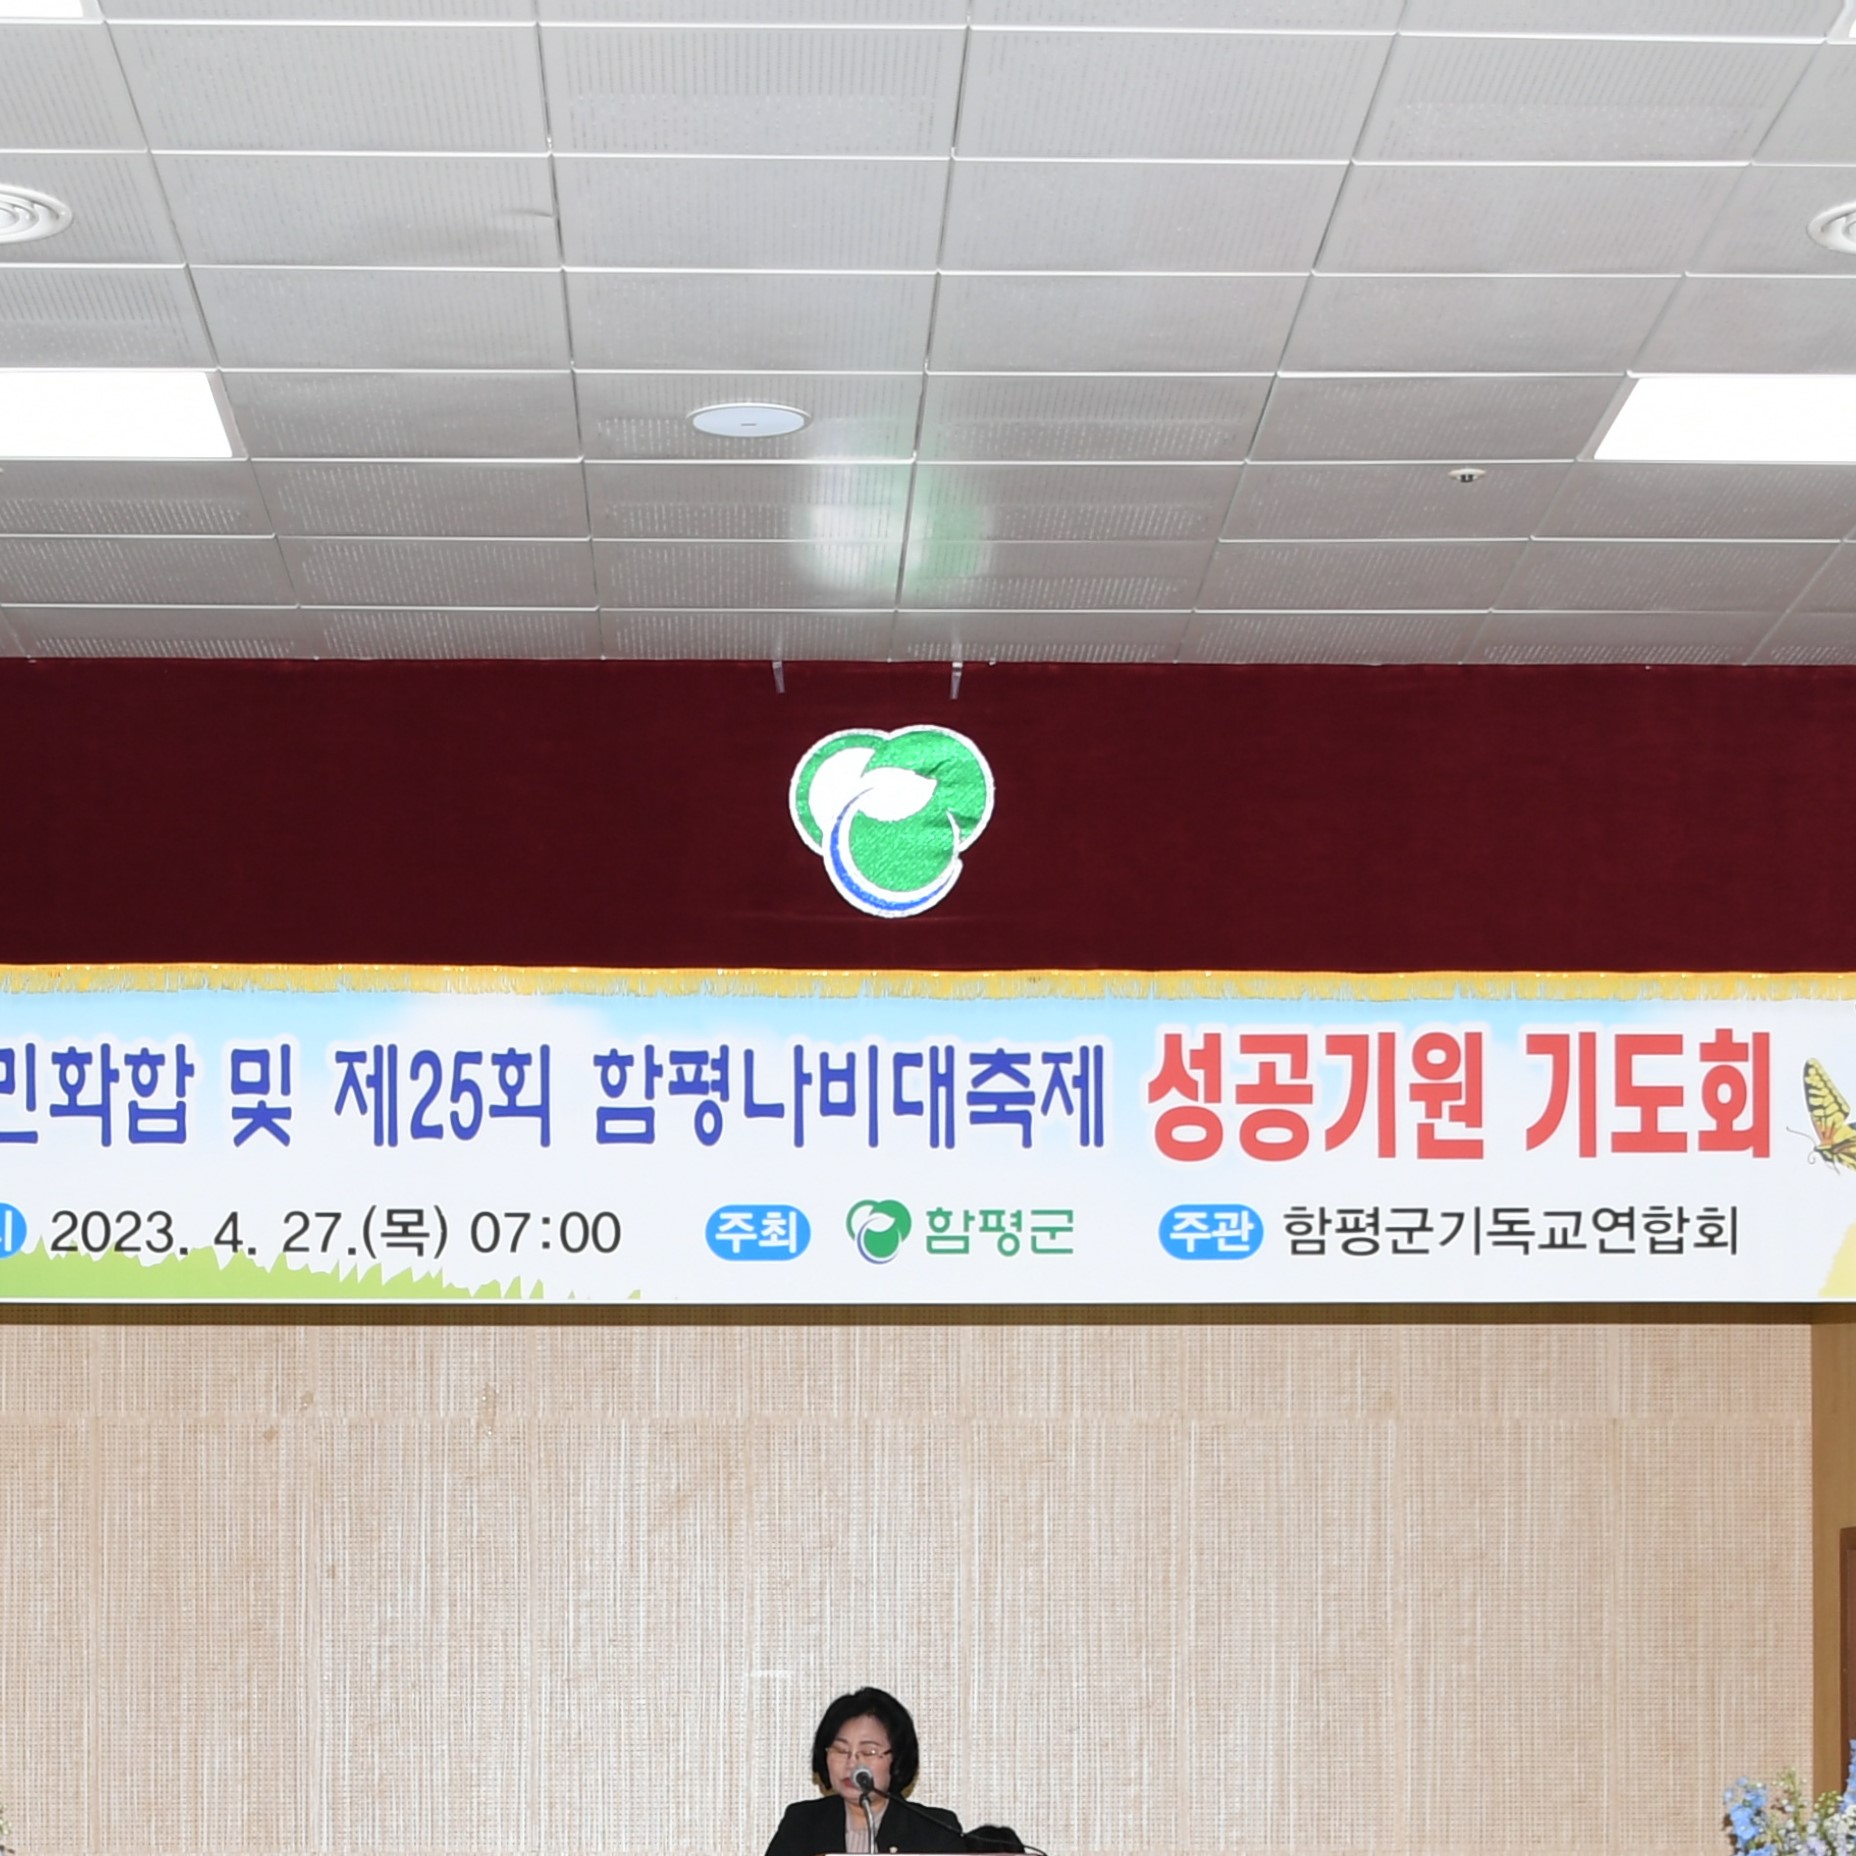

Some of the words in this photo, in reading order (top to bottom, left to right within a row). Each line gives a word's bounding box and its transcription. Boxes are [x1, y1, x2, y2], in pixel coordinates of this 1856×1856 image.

[230, 1043, 293, 1146] 및
[334, 1043, 552, 1147] 제25회
[592, 1043, 1105, 1149] 함평나비대축제
[1148, 1031, 1485, 1163] 성공기원
[1526, 1027, 1771, 1159] 기도회
[50, 1209, 189, 1256] 2023.
[213, 1210, 257, 1256] 4.
[282, 1204, 449, 1260] 27.(목)
[470, 1210, 622, 1254] 07:00
[718, 1208, 798, 1256] 주최
[926, 1206, 1075, 1257] 함평군
[1171, 1208, 1252, 1256] 주관
[1283, 1205, 1738, 1257] 함평군기독교연합회
